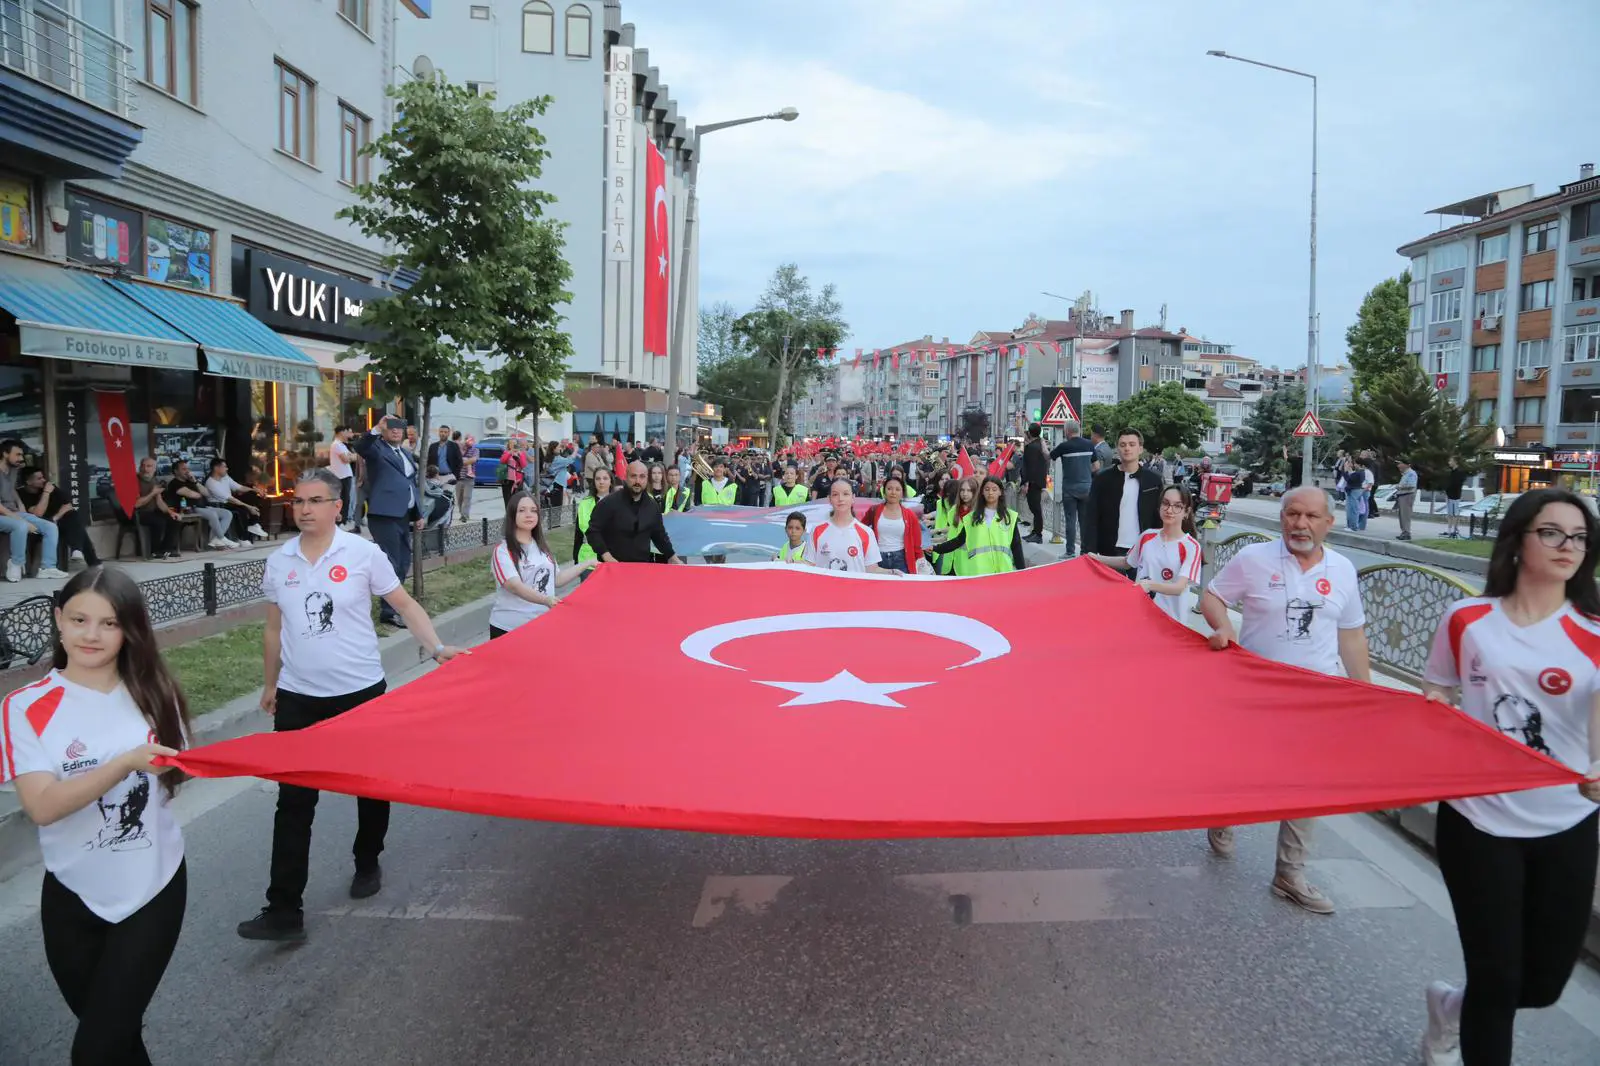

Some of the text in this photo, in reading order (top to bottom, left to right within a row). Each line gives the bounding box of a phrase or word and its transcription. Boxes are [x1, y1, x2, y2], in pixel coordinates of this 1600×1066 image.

[614, 86, 628, 165] HOTEL
[612, 175, 626, 254] BALTA
[65, 336, 169, 362] Fotokopi & Fax
[221, 359, 251, 377] ALYA
[67, 401, 76, 435] ALYA
[62, 757, 98, 773] Edirne
